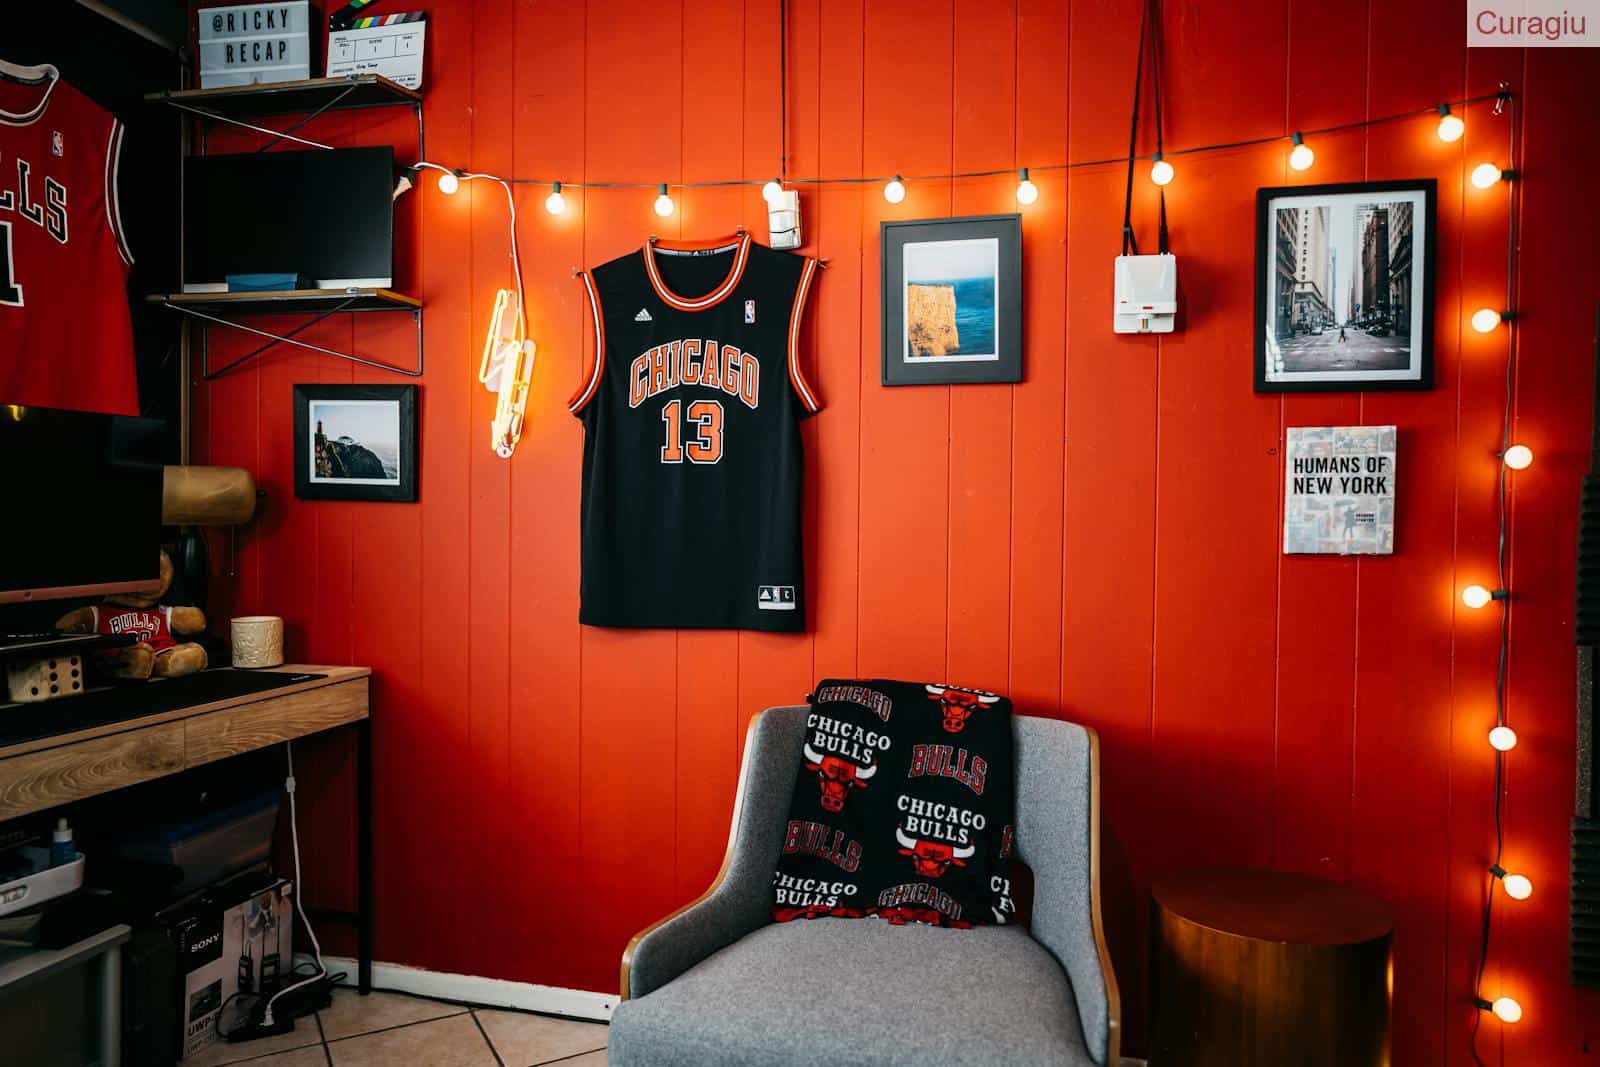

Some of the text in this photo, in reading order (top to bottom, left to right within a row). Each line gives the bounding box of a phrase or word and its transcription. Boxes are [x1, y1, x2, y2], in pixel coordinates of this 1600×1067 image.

[212, 8, 288, 33] @RICKY
[226, 40, 287, 63] RECAP
[629, 339, 760, 409] CHICAGO
[660, 400, 724, 464] 13
[1294, 457, 1388, 474] HUMANS OF
[1293, 476, 1387, 495] NEW YORK
[818, 686, 893, 722] CHICAGO
[807, 713, 892, 751] CHICAGO
[813, 730, 874, 765] BULLS
[908, 744, 988, 795] BULLS
[897, 795, 986, 831] CHICAGO
[905, 815, 970, 845] BULLS
[784, 820, 863, 873] BULLS
[774, 871, 858, 896] HICAGO
[776, 888, 838, 908] BULLS
[190, 932, 222, 953] SONY
